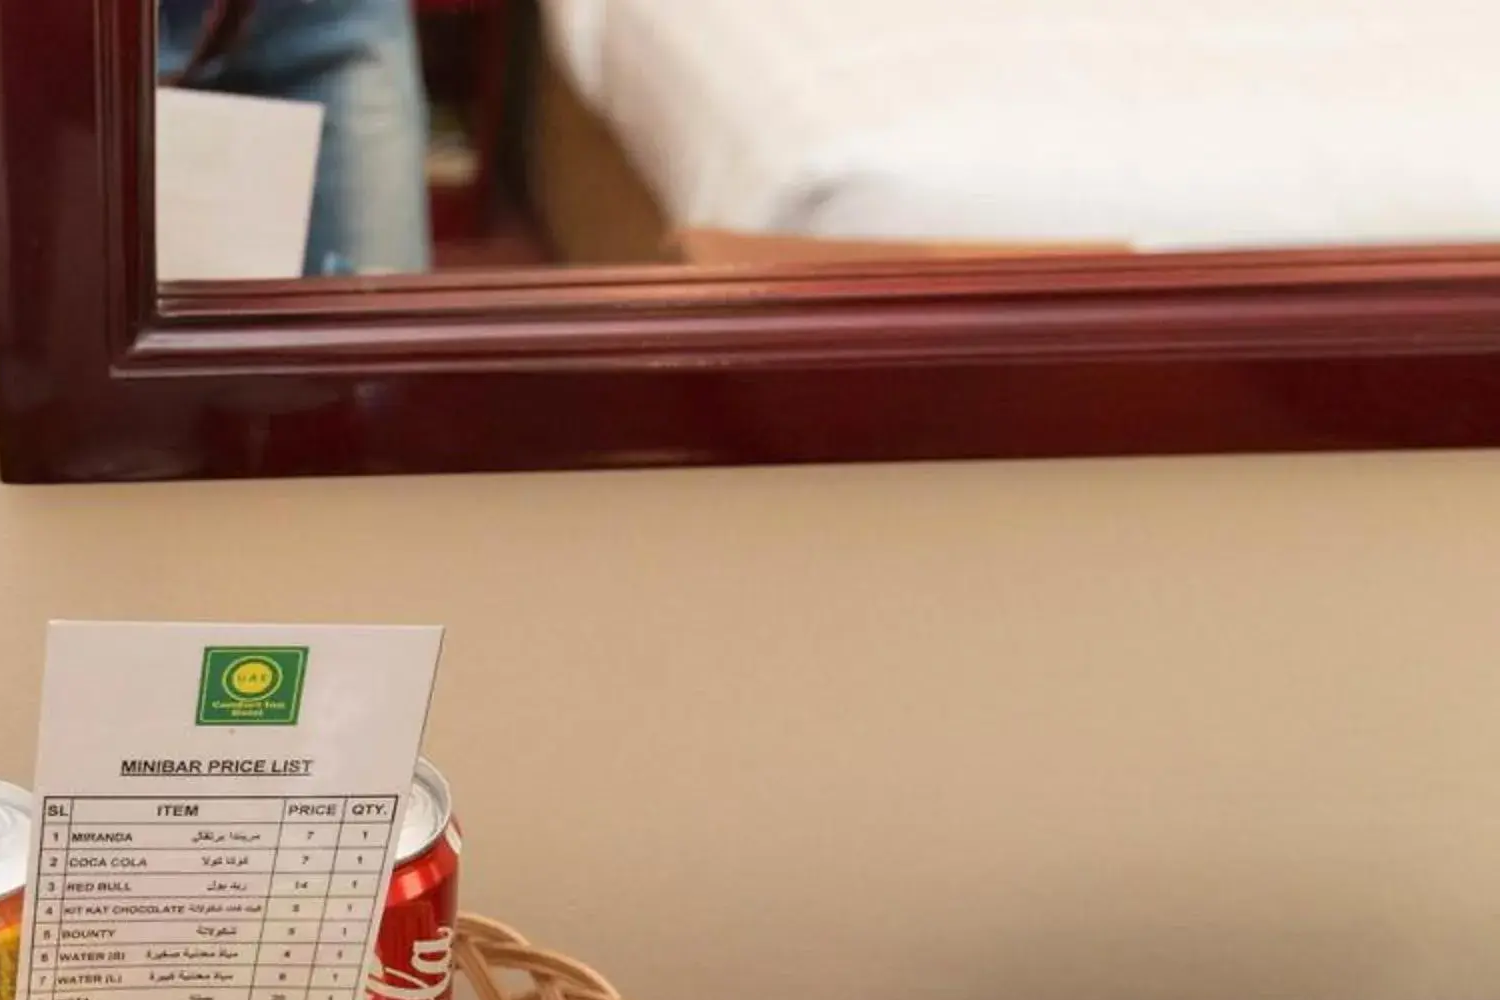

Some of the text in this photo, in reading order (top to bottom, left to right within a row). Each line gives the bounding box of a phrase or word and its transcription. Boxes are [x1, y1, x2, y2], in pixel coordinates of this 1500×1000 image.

[120, 759, 314, 775] MINIBAR PRICE LIST
[47, 804, 68, 817] SL
[156, 804, 200, 817] ITEM
[287, 803, 337, 816] PRICE
[351, 803, 388, 816] QTY.
[52, 832, 59, 842] 1
[71, 832, 133, 843] MIRANDA
[306, 831, 315, 840] 7
[49, 857, 58, 867] 2
[69, 857, 148, 868] COCA COLA
[66, 882, 132, 892] RED BULL
[45, 906, 53, 915] 4
[64, 905, 185, 915] KIT KAT CHOCOLATE
[61, 929, 117, 940] BOUNTY
[59, 952, 105, 962] WATER
[57, 974, 102, 985] WATER
